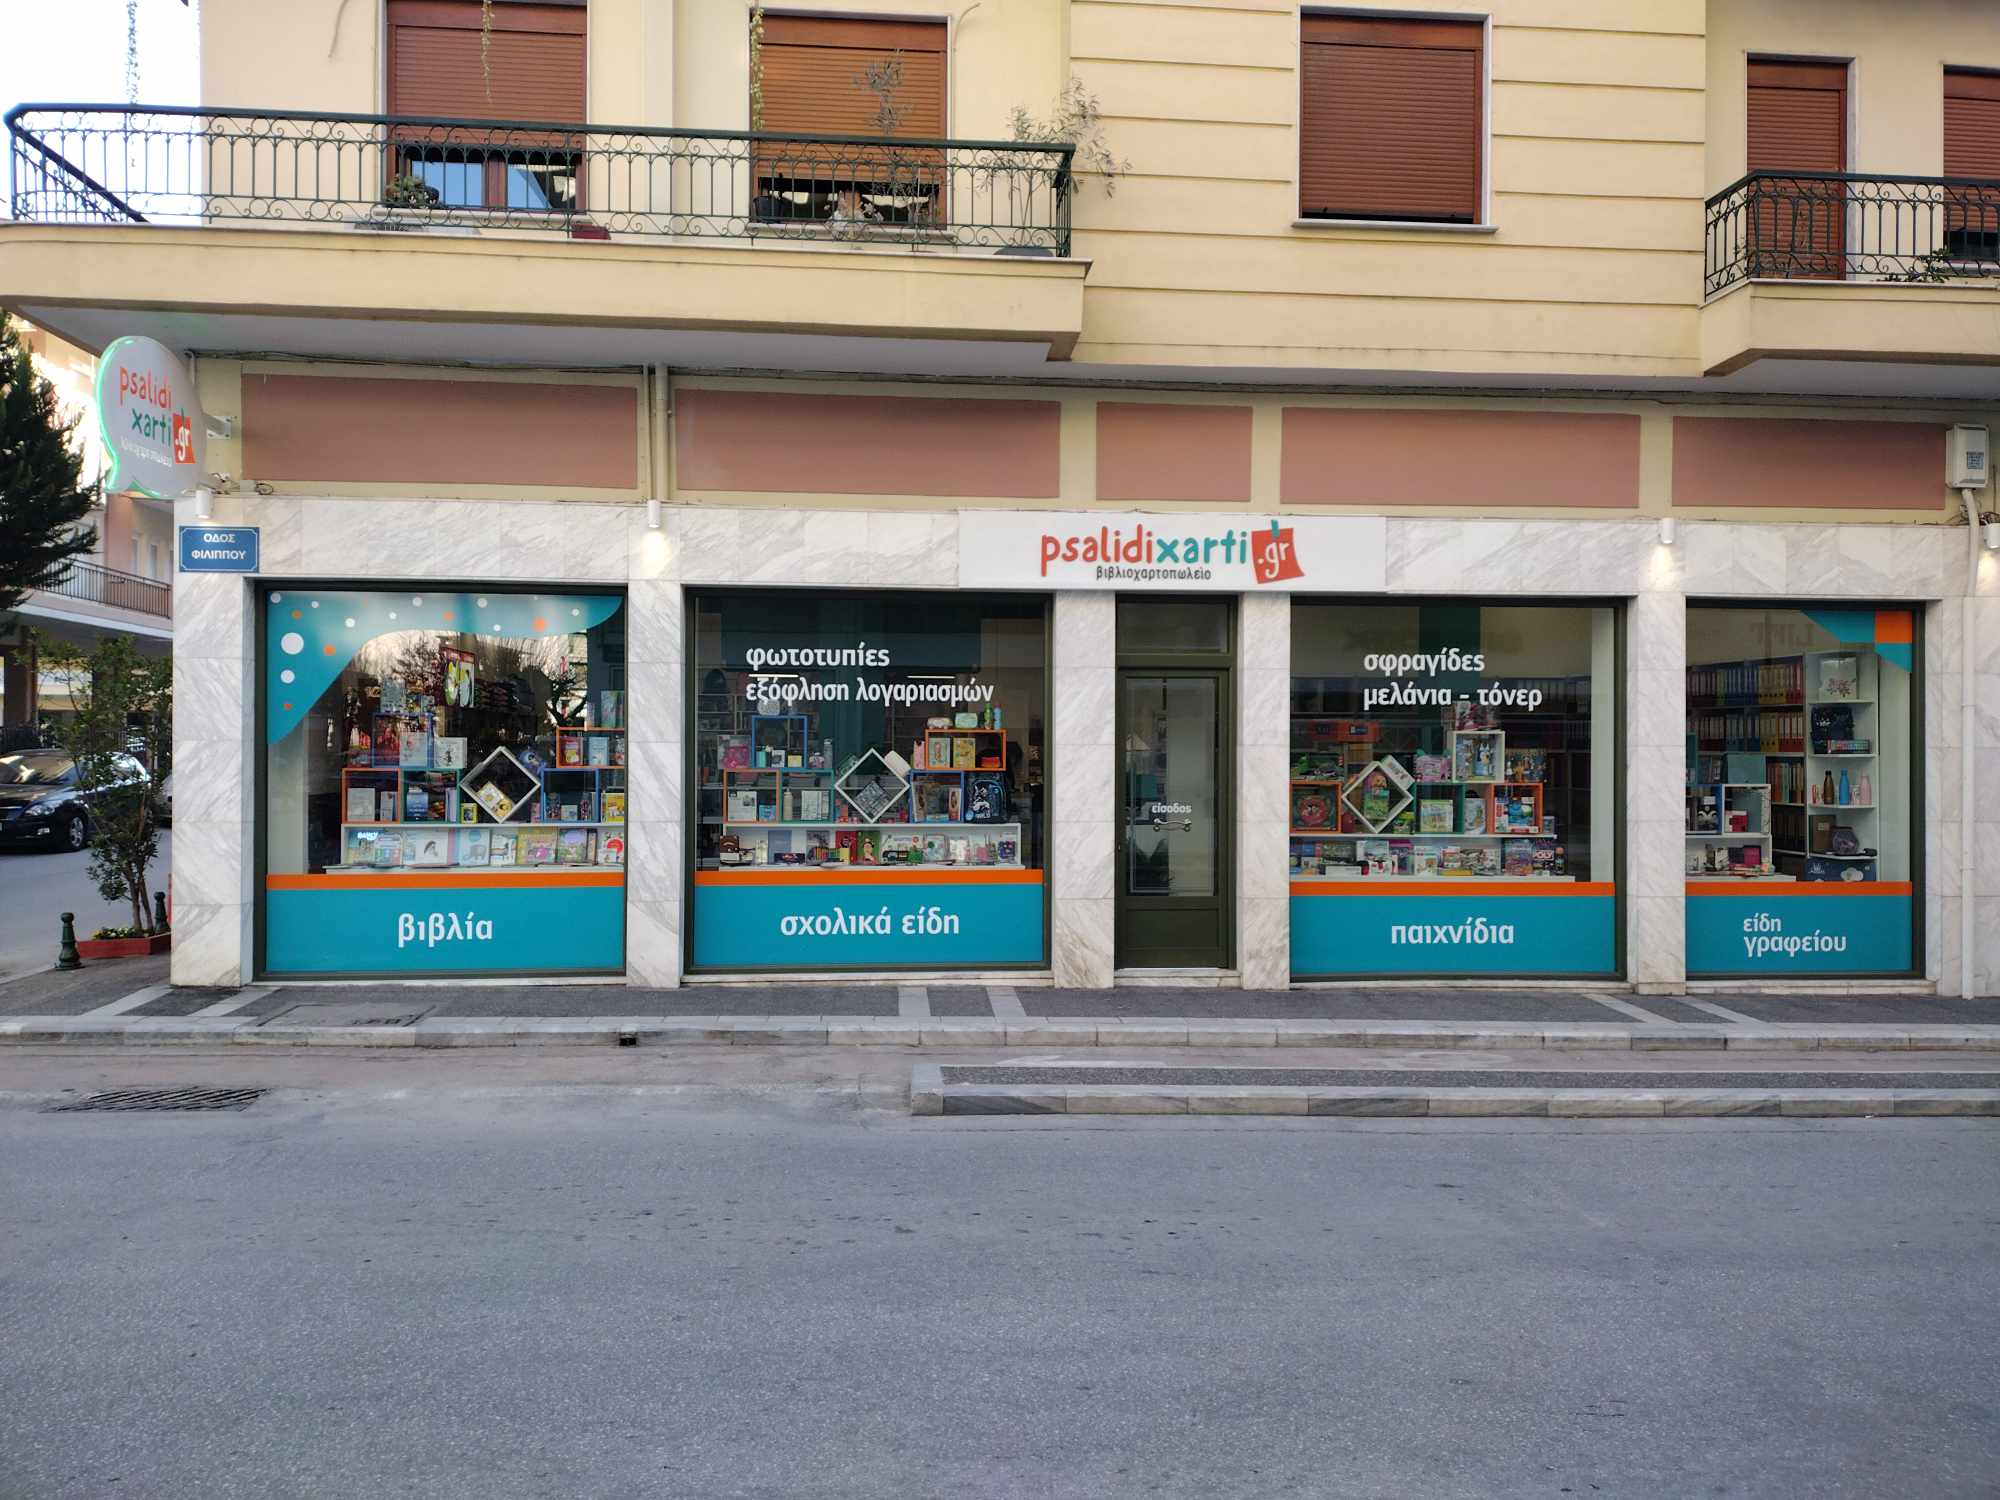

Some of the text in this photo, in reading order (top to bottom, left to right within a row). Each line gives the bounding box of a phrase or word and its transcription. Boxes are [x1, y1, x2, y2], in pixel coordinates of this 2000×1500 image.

[120, 366, 172, 411] psalidi
[203, 533, 236, 543] ΟΔΟΣ
[191, 549, 247, 560] ΦΙΛΙΠΠΟΥ
[1096, 566, 1212, 581] βιβλιοχαρτοπωλείο
[746, 641, 890, 671] φωτοτυπίες
[1364, 647, 1485, 677] σφραγίδες
[746, 677, 995, 707] εξόφληση λογαριασμών
[1364, 682, 1452, 711] μελάνια
[1477, 682, 1543, 712] τόνερ
[1151, 802, 1192, 814] είσοδος
[398, 912, 493, 948] βιβλία
[781, 907, 960, 936] σχολικά είδη
[1391, 917, 1515, 944] παιχνίδια
[1743, 912, 1782, 932] είδη
[1743, 929, 1847, 957] γραφείου
